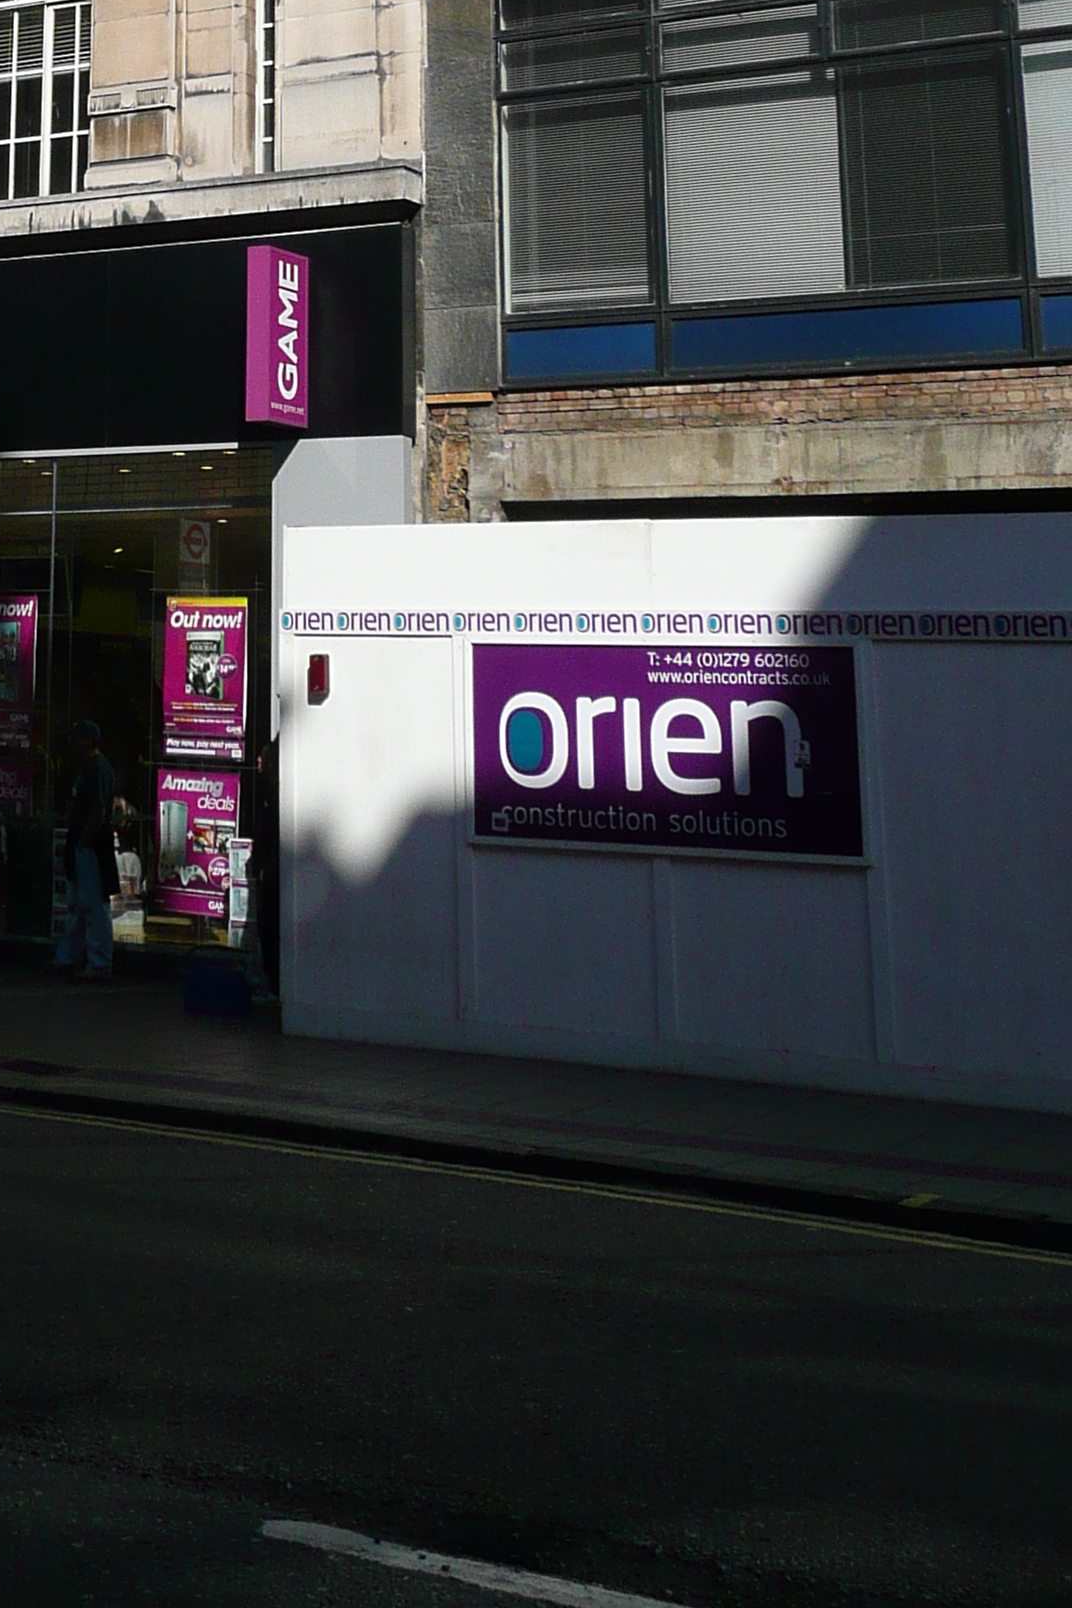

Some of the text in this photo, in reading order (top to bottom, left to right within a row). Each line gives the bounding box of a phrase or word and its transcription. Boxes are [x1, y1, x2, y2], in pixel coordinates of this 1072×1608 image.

[278, 260, 299, 401] GAME
[170, 610, 243, 629] Out now!
[282, 611, 1066, 638] orien orien orien orien orien orien orien orien orien orien orien orien
[647, 652, 810, 668] T: +44 (0)1279 602160
[647, 669, 831, 686] www.oriencontracts.co.uk
[499, 691, 805, 798] orien
[161, 774, 224, 798] Amazing
[197, 794, 235, 811] deals
[501, 803, 788, 838] construction solutions
